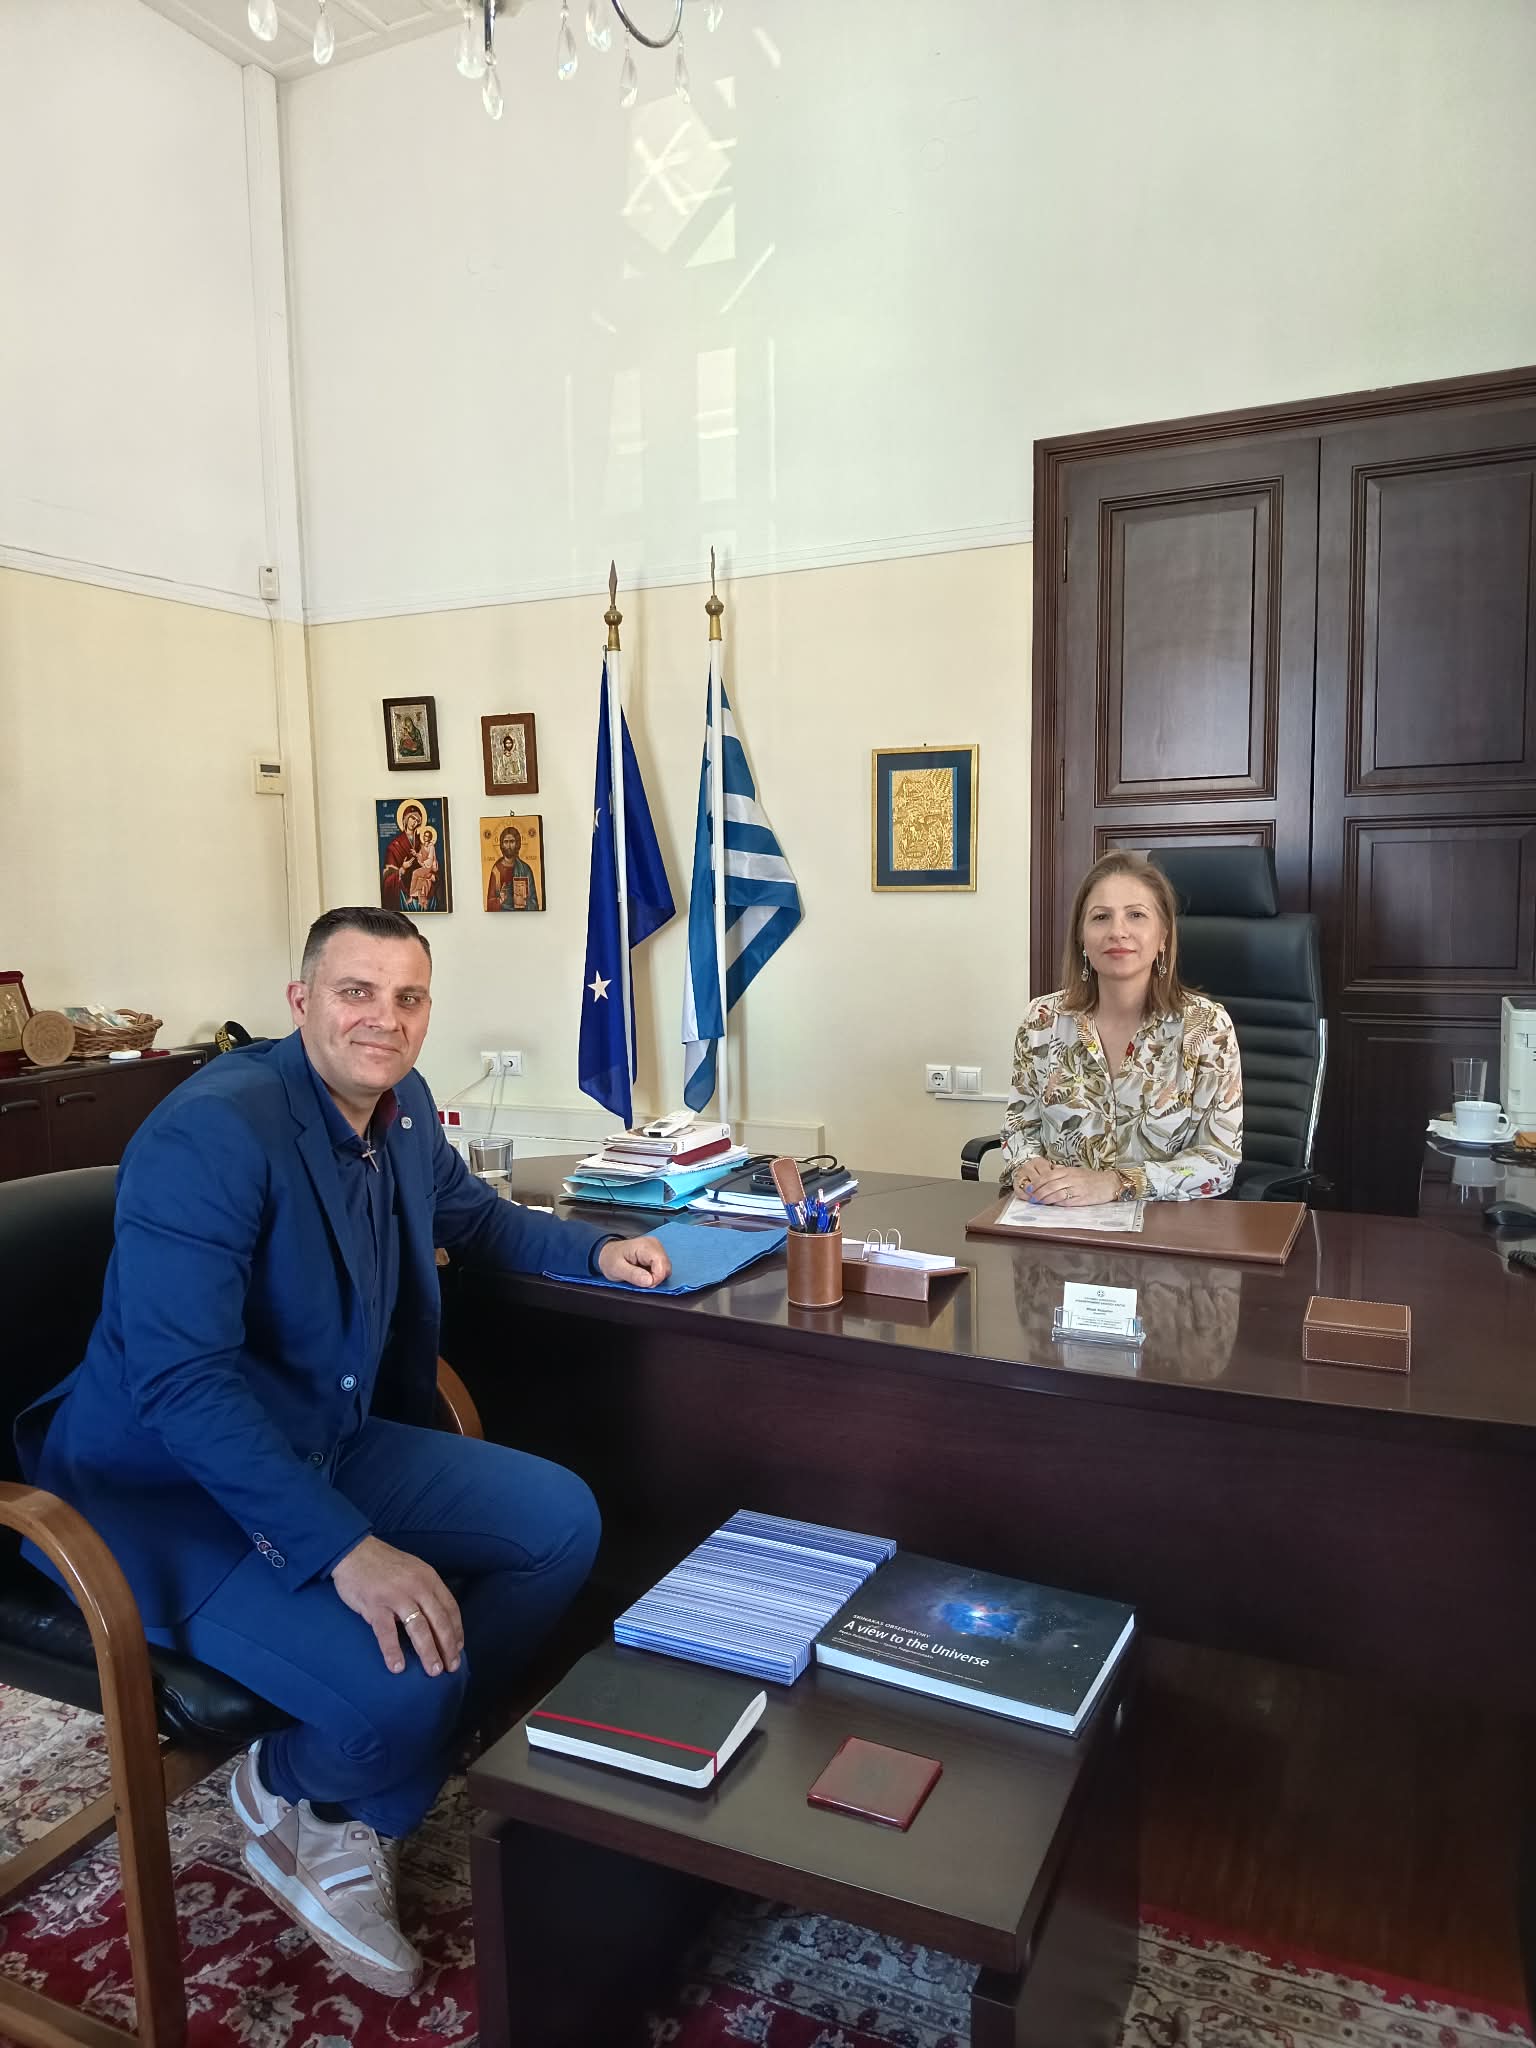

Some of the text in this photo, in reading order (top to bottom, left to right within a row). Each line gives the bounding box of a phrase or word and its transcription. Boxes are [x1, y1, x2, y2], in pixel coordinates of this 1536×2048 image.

[843, 1620, 855, 1631] A
[857, 1625, 889, 1639] view
[890, 1634, 904, 1644] to
[905, 1638, 929, 1651] the
[931, 1644, 990, 1667] Universe
[852, 1614, 931, 1638] SKINAKAS OBSERVATORY
